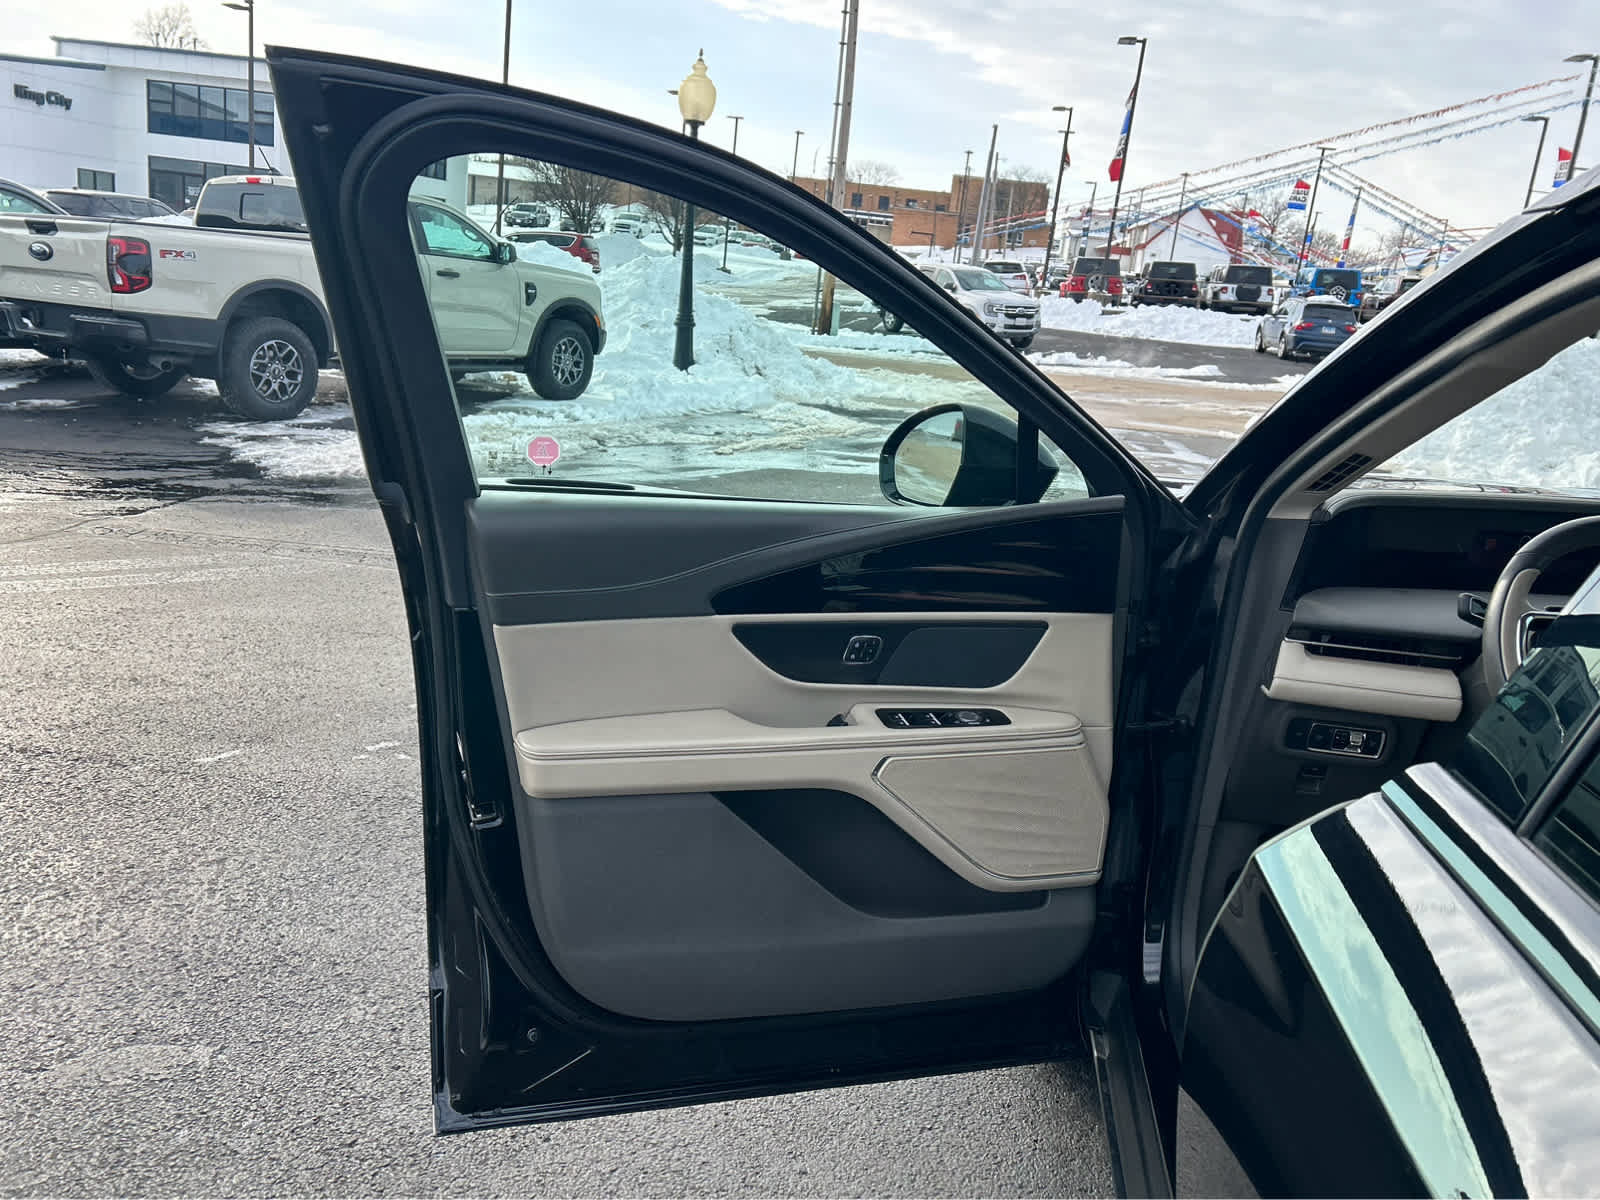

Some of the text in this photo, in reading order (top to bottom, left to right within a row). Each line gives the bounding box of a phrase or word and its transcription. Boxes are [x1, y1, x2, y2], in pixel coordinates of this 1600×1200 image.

[13, 83, 72, 110] King City
[159, 249, 196, 259] FX4
[11, 278, 98, 299] ANGER
